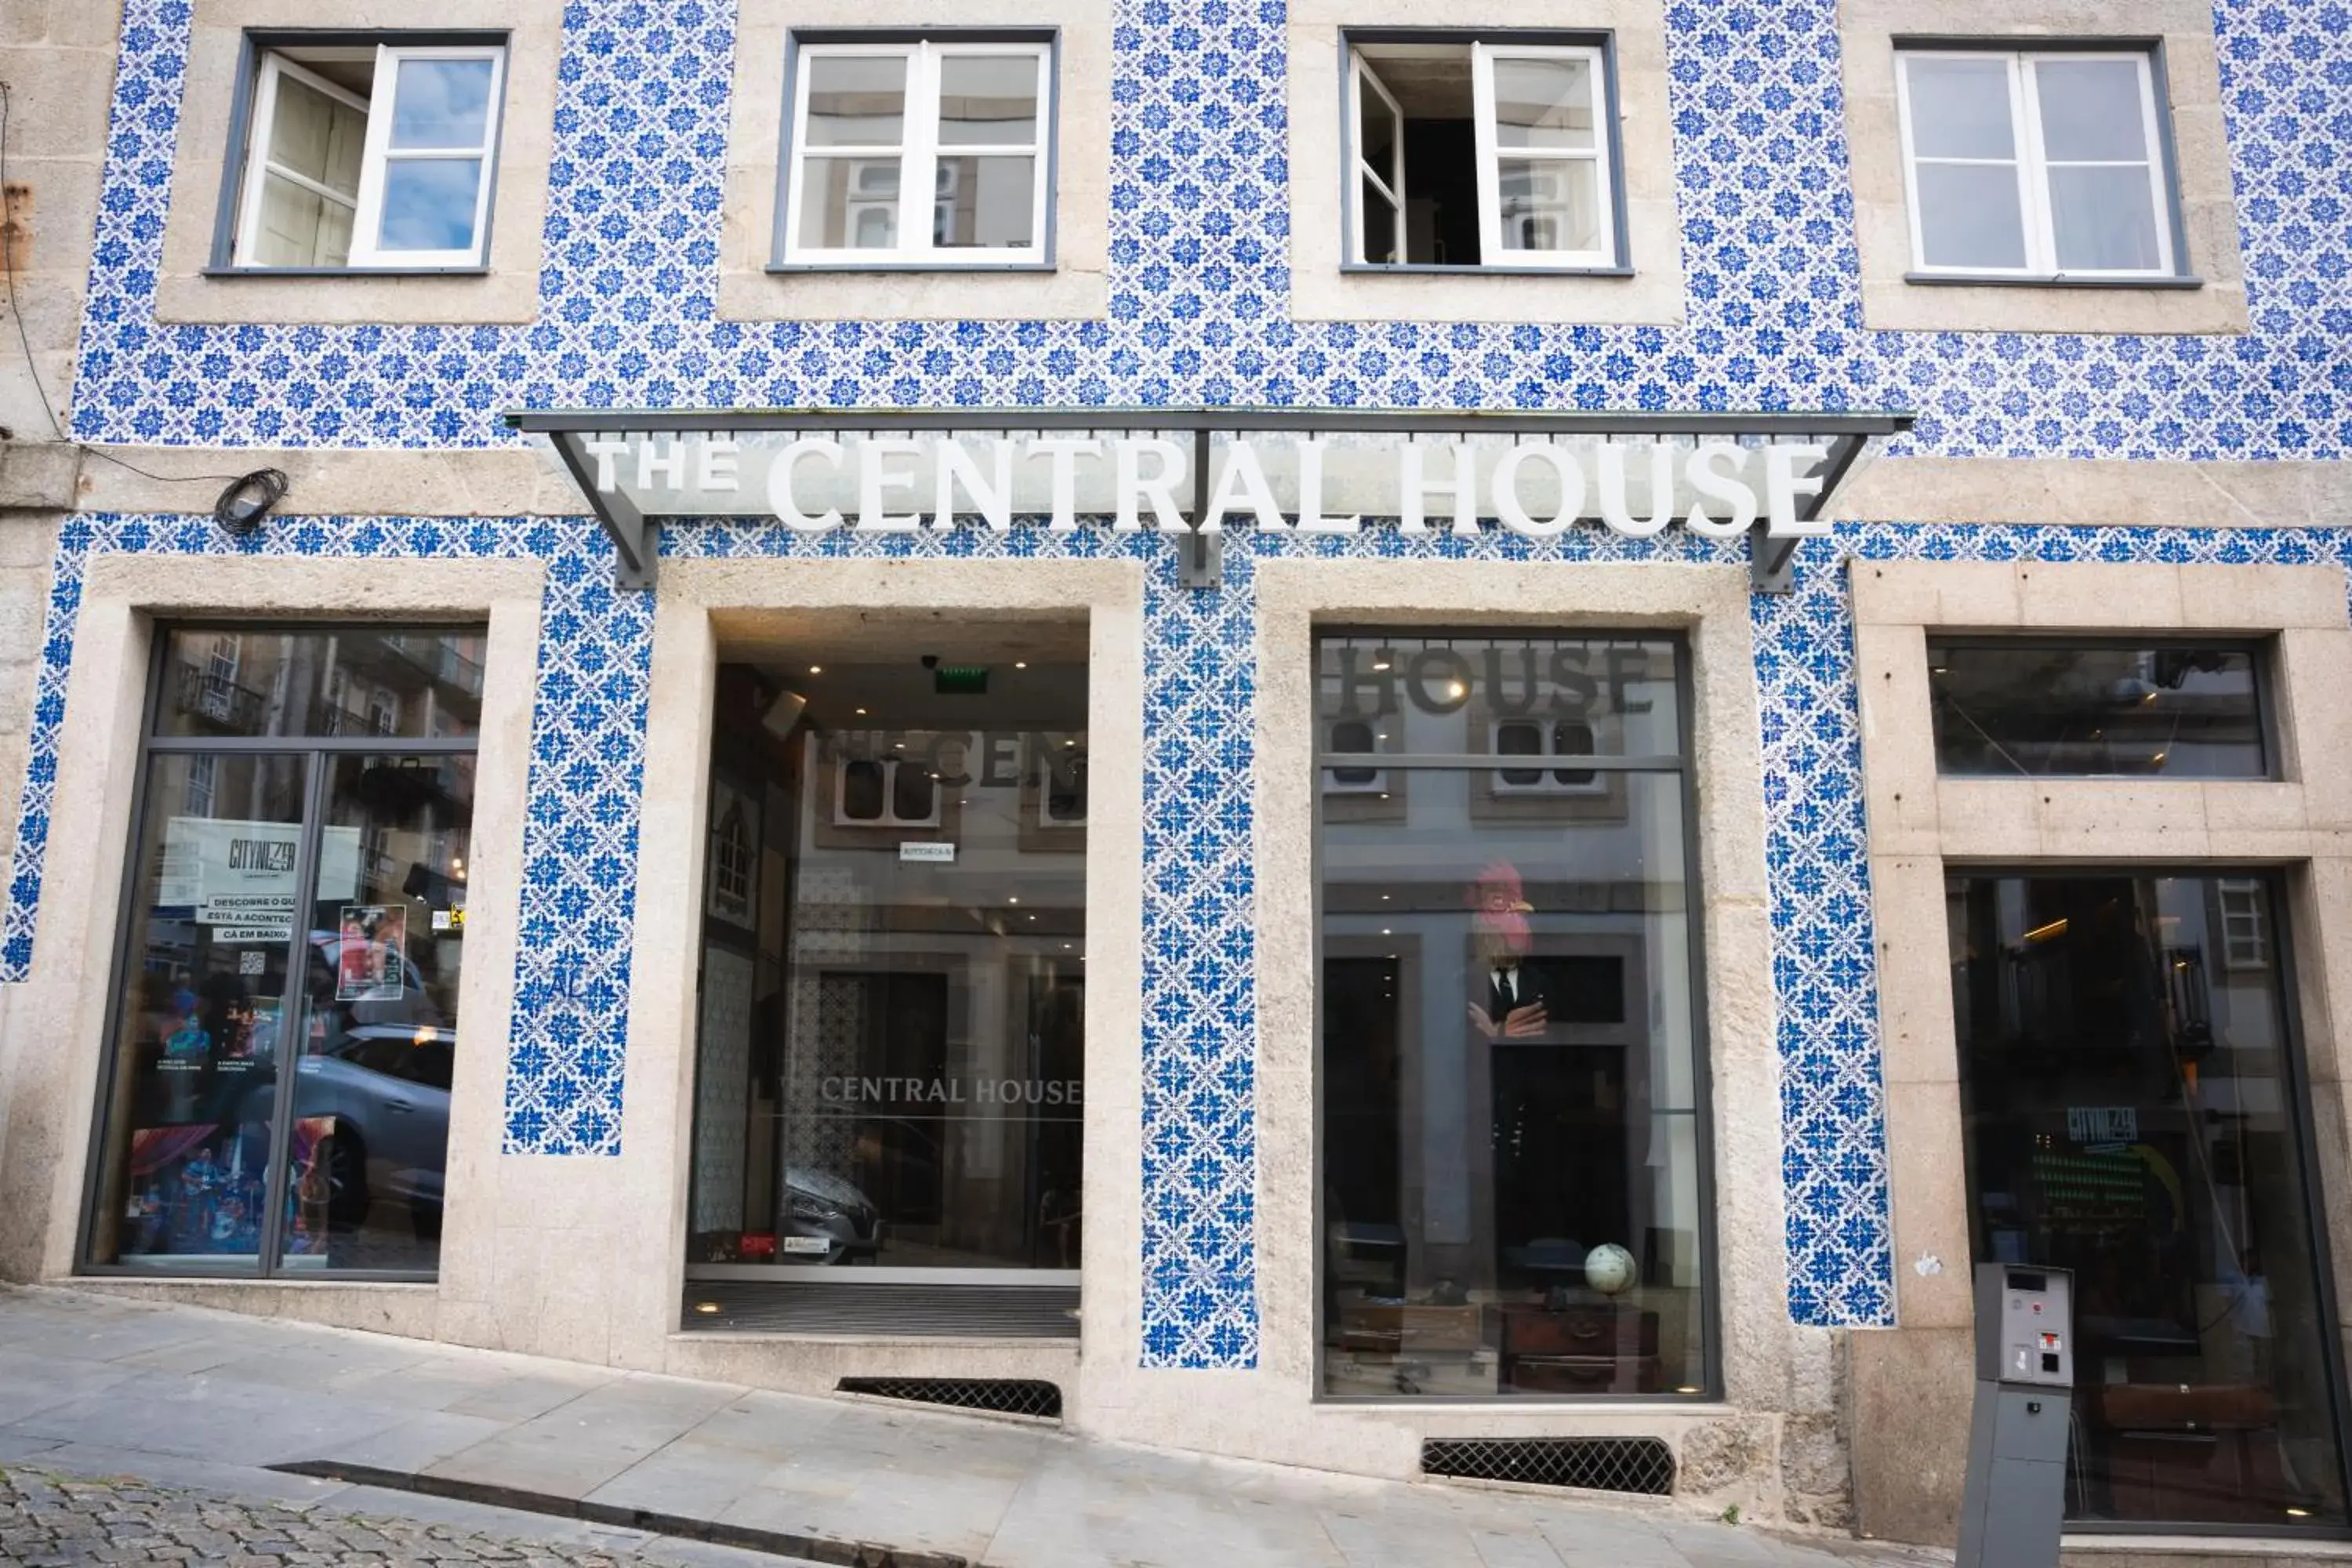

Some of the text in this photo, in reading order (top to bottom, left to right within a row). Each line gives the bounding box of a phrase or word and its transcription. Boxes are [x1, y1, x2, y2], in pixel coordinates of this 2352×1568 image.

[585, 438, 1835, 539] THE CENTRAL HOUSE
[1337, 648, 1654, 716] HOUSE
[228, 839, 296, 872] CITYNIZER
[214, 898, 270, 906] DESCOBRE
[256, 931, 288, 939] BAIXO
[821, 1076, 965, 1102] CENTRAL
[976, 1080, 1082, 1105] HOUSE
